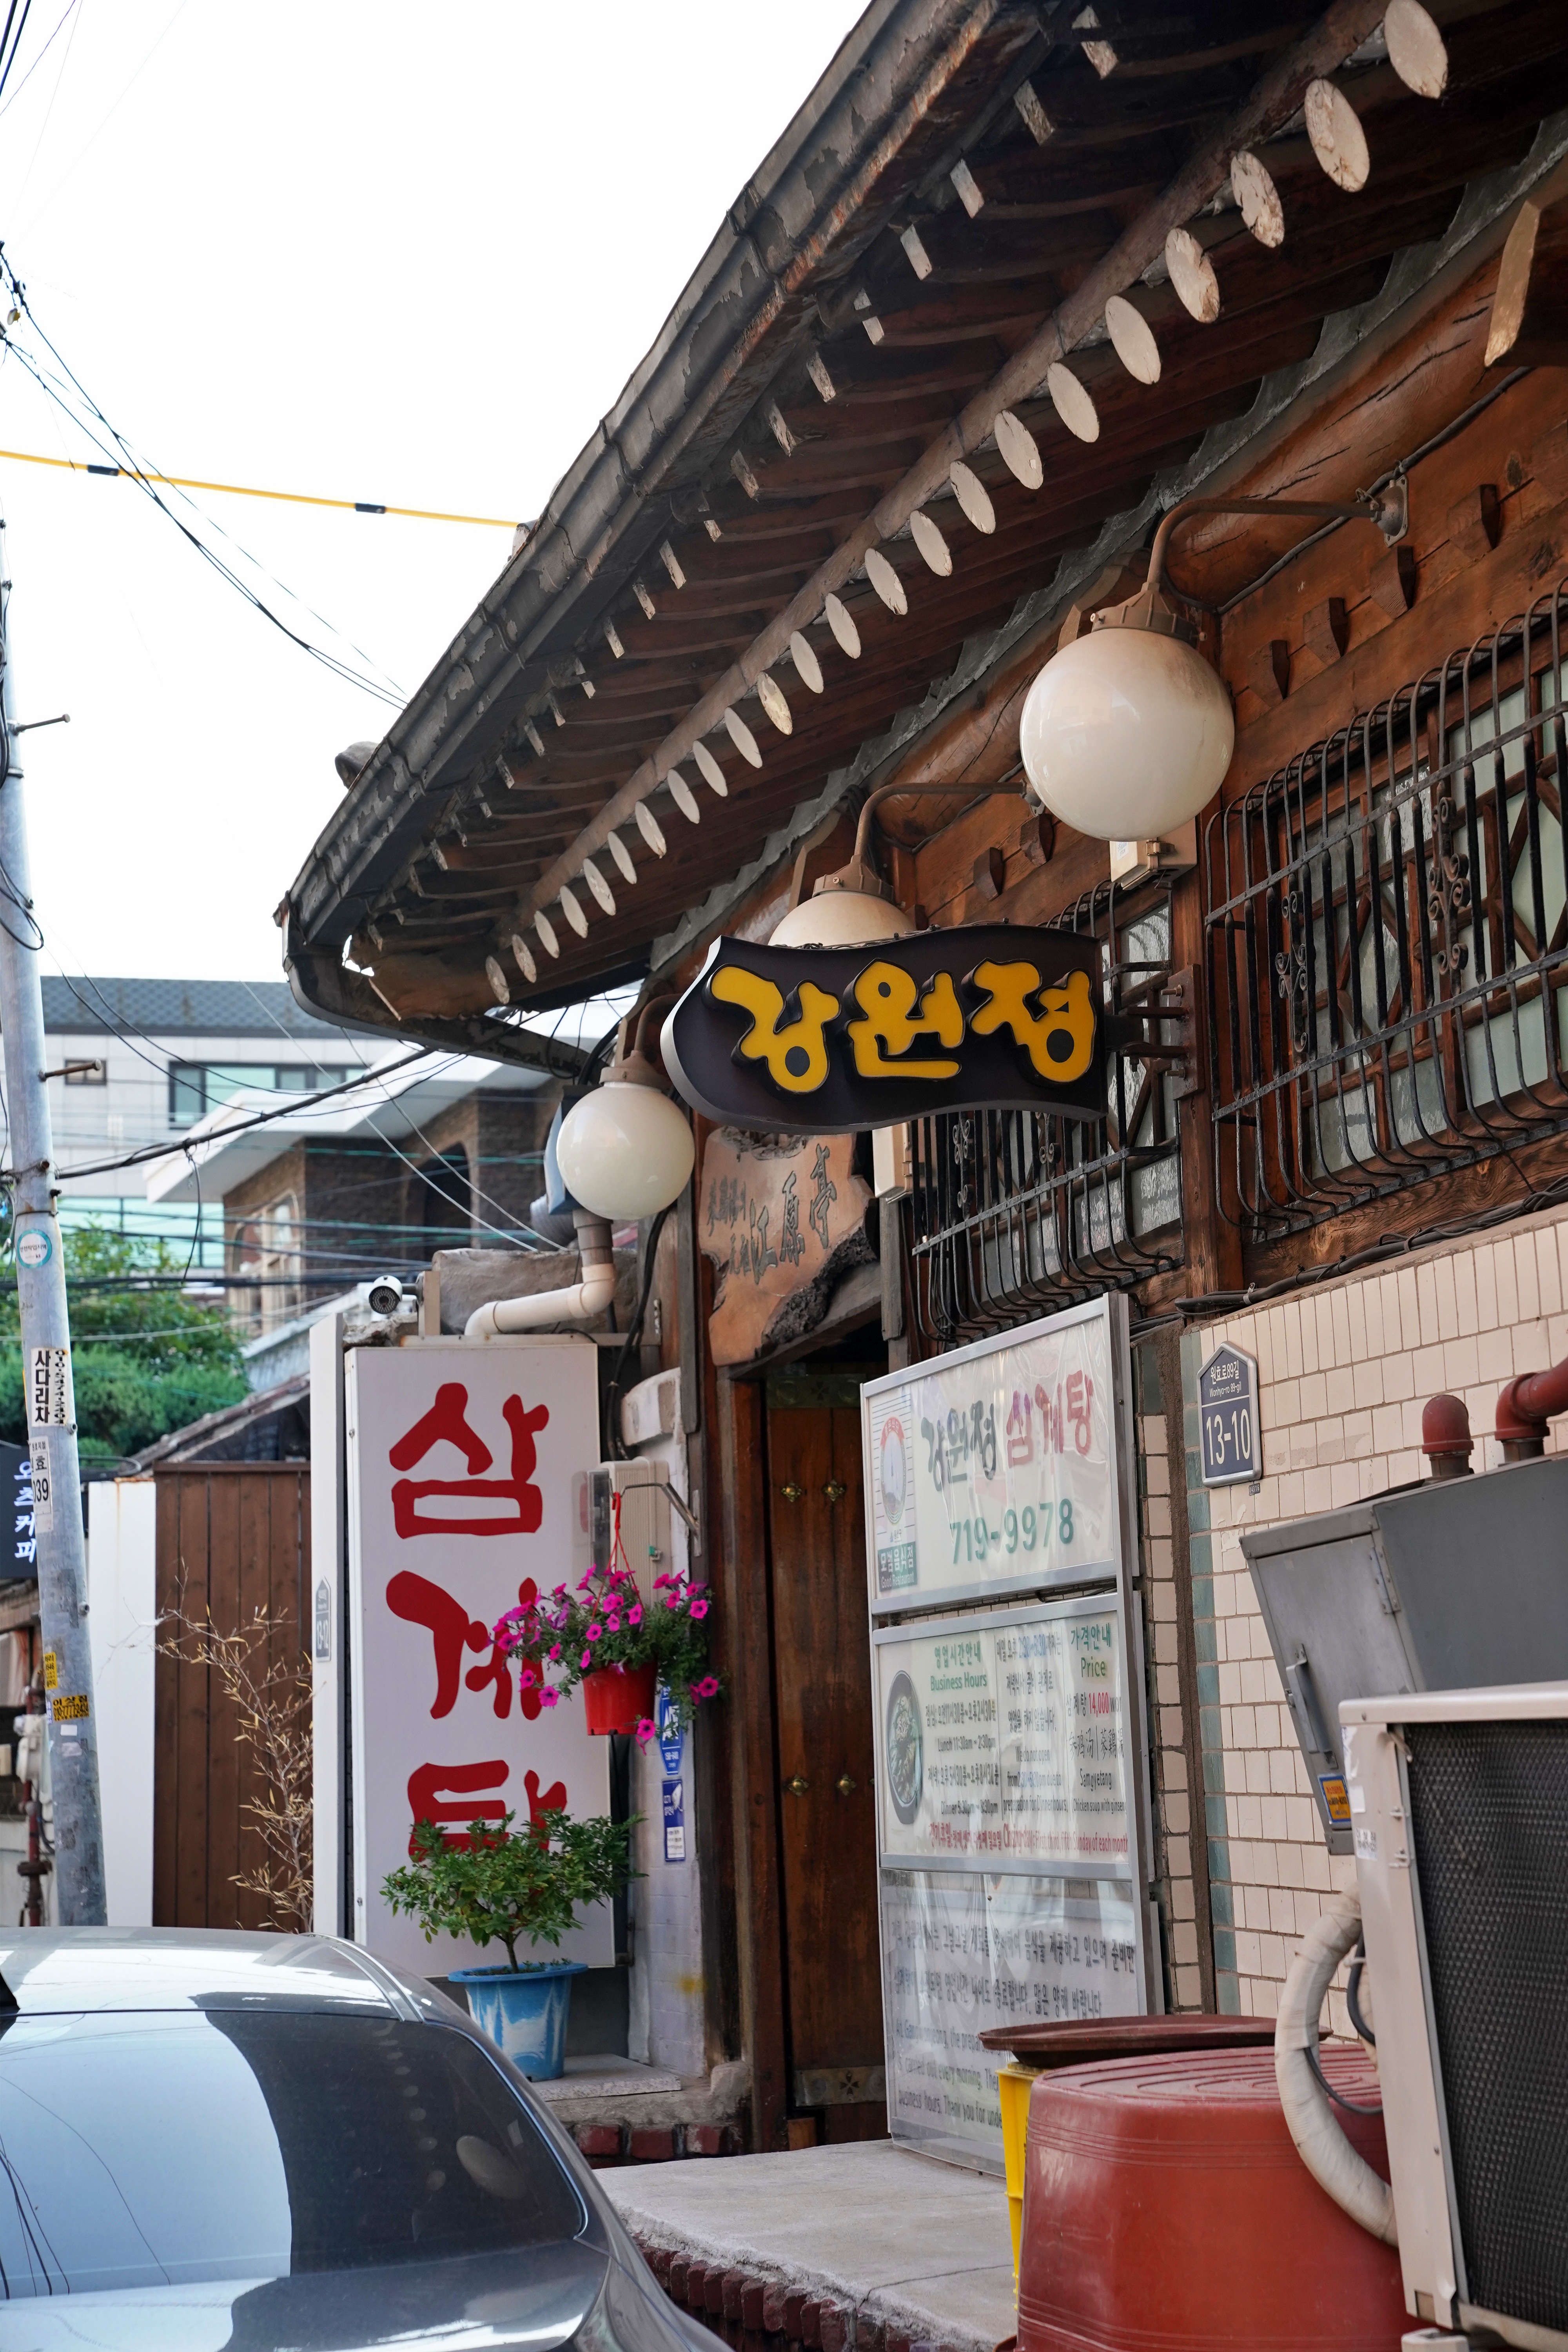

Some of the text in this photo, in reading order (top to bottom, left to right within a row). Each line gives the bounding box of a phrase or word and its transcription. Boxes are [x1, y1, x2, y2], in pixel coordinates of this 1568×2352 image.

[711, 960, 1094, 1093] 강원정
[1210, 1359, 1240, 1385] 원효로89길
[35, 1350, 51, 1424] 사다리차
[1209, 1381, 1241, 1397] Wonhyo-ro 89-gil
[921, 1370, 1094, 1492] 강원정 삼계탕
[1206, 1408, 1250, 1465] 13-10
[949, 1498, 1074, 1564] 719-9978
[880, 1546, 914, 1572] 모범음식점
[881, 1571, 915, 1589] Good Restaurant
[1071, 1622, 1111, 1651] 가격안내
[1007, 1637, 1017, 1660] 오후
[1081, 1656, 1106, 1678] Price
[930, 1671, 987, 1691] Business Hours
[1089, 1692, 1109, 1718] 14,000
[938, 1737, 952, 1752] Lunch
[978, 1734, 996, 1751] 2:30pm
[1015, 1746, 1050, 1765] We do not open
[1047, 1769, 1056, 1786] due
[1056, 1771, 1062, 1786] to
[1080, 1768, 1112, 1792] Samgyetang
[941, 1801, 957, 1815] Dinner
[1003, 1795, 1029, 1815] preparation
[1037, 1795, 1052, 1811] Dinner
[1071, 1798, 1089, 1814] (Chicken
[1090, 1801, 1100, 1815] soup
[1101, 1798, 1110, 1812] with
[1073, 1831, 1091, 1855] Sunday
[1092, 1832, 1098, 1851] of
[1099, 1832, 1111, 1851] each
[1112, 1832, 1128, 1853] month
[963, 2103, 975, 2122] you
[976, 2100, 985, 2123] for
